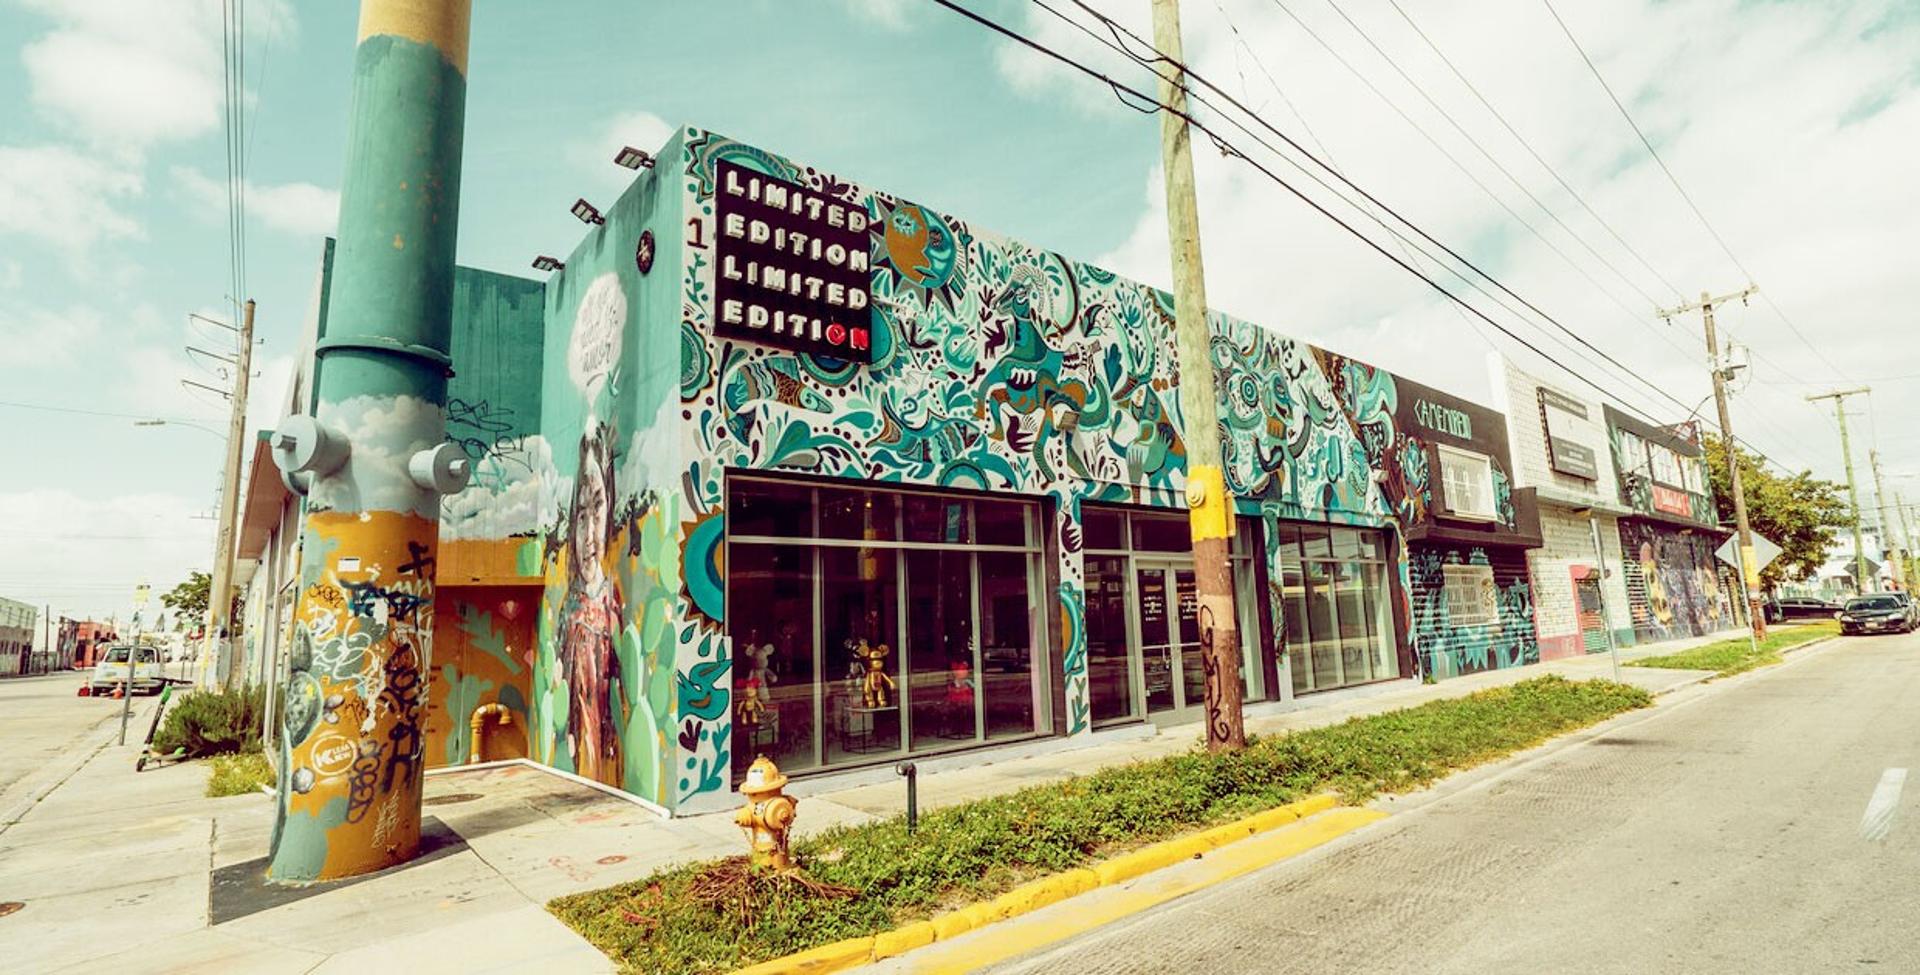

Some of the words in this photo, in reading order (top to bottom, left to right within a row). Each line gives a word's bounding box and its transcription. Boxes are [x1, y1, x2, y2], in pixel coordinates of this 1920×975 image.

[726, 170, 867, 233] LIMITED
[725, 213, 868, 272] EDITION
[723, 255, 867, 310] LIMITED
[722, 299, 869, 350] EDITION
